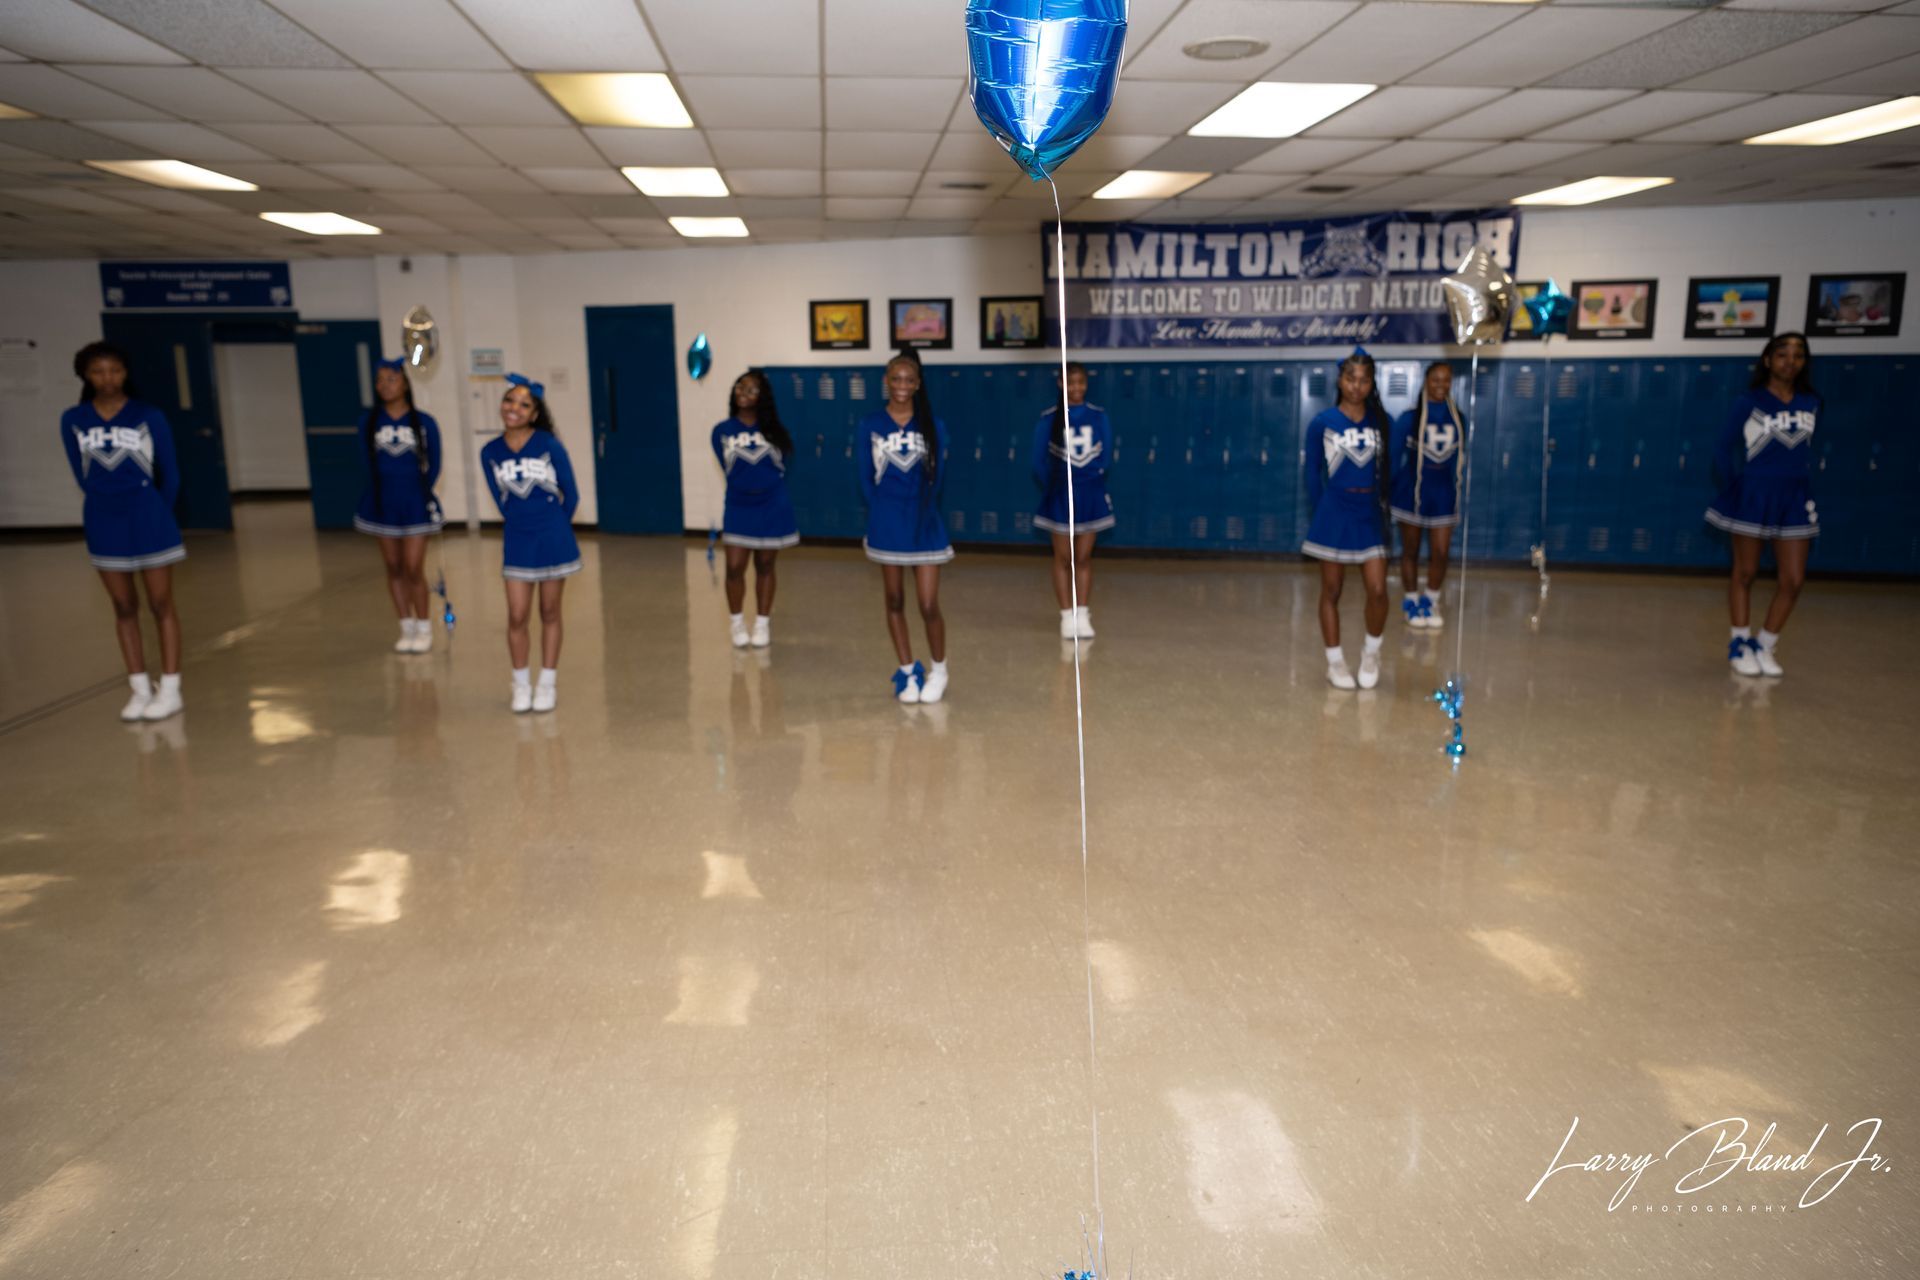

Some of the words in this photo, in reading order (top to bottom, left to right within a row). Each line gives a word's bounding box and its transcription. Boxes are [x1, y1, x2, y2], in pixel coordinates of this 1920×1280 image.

[1048, 231, 1303, 279] HAMILTON
[1386, 218, 1514, 271] HIGH
[1089, 287, 1202, 315] WELCOME
[1211, 286, 1241, 313] TO
[1251, 283, 1361, 313] WILDCAT
[1370, 280, 1443, 310] NATIO
